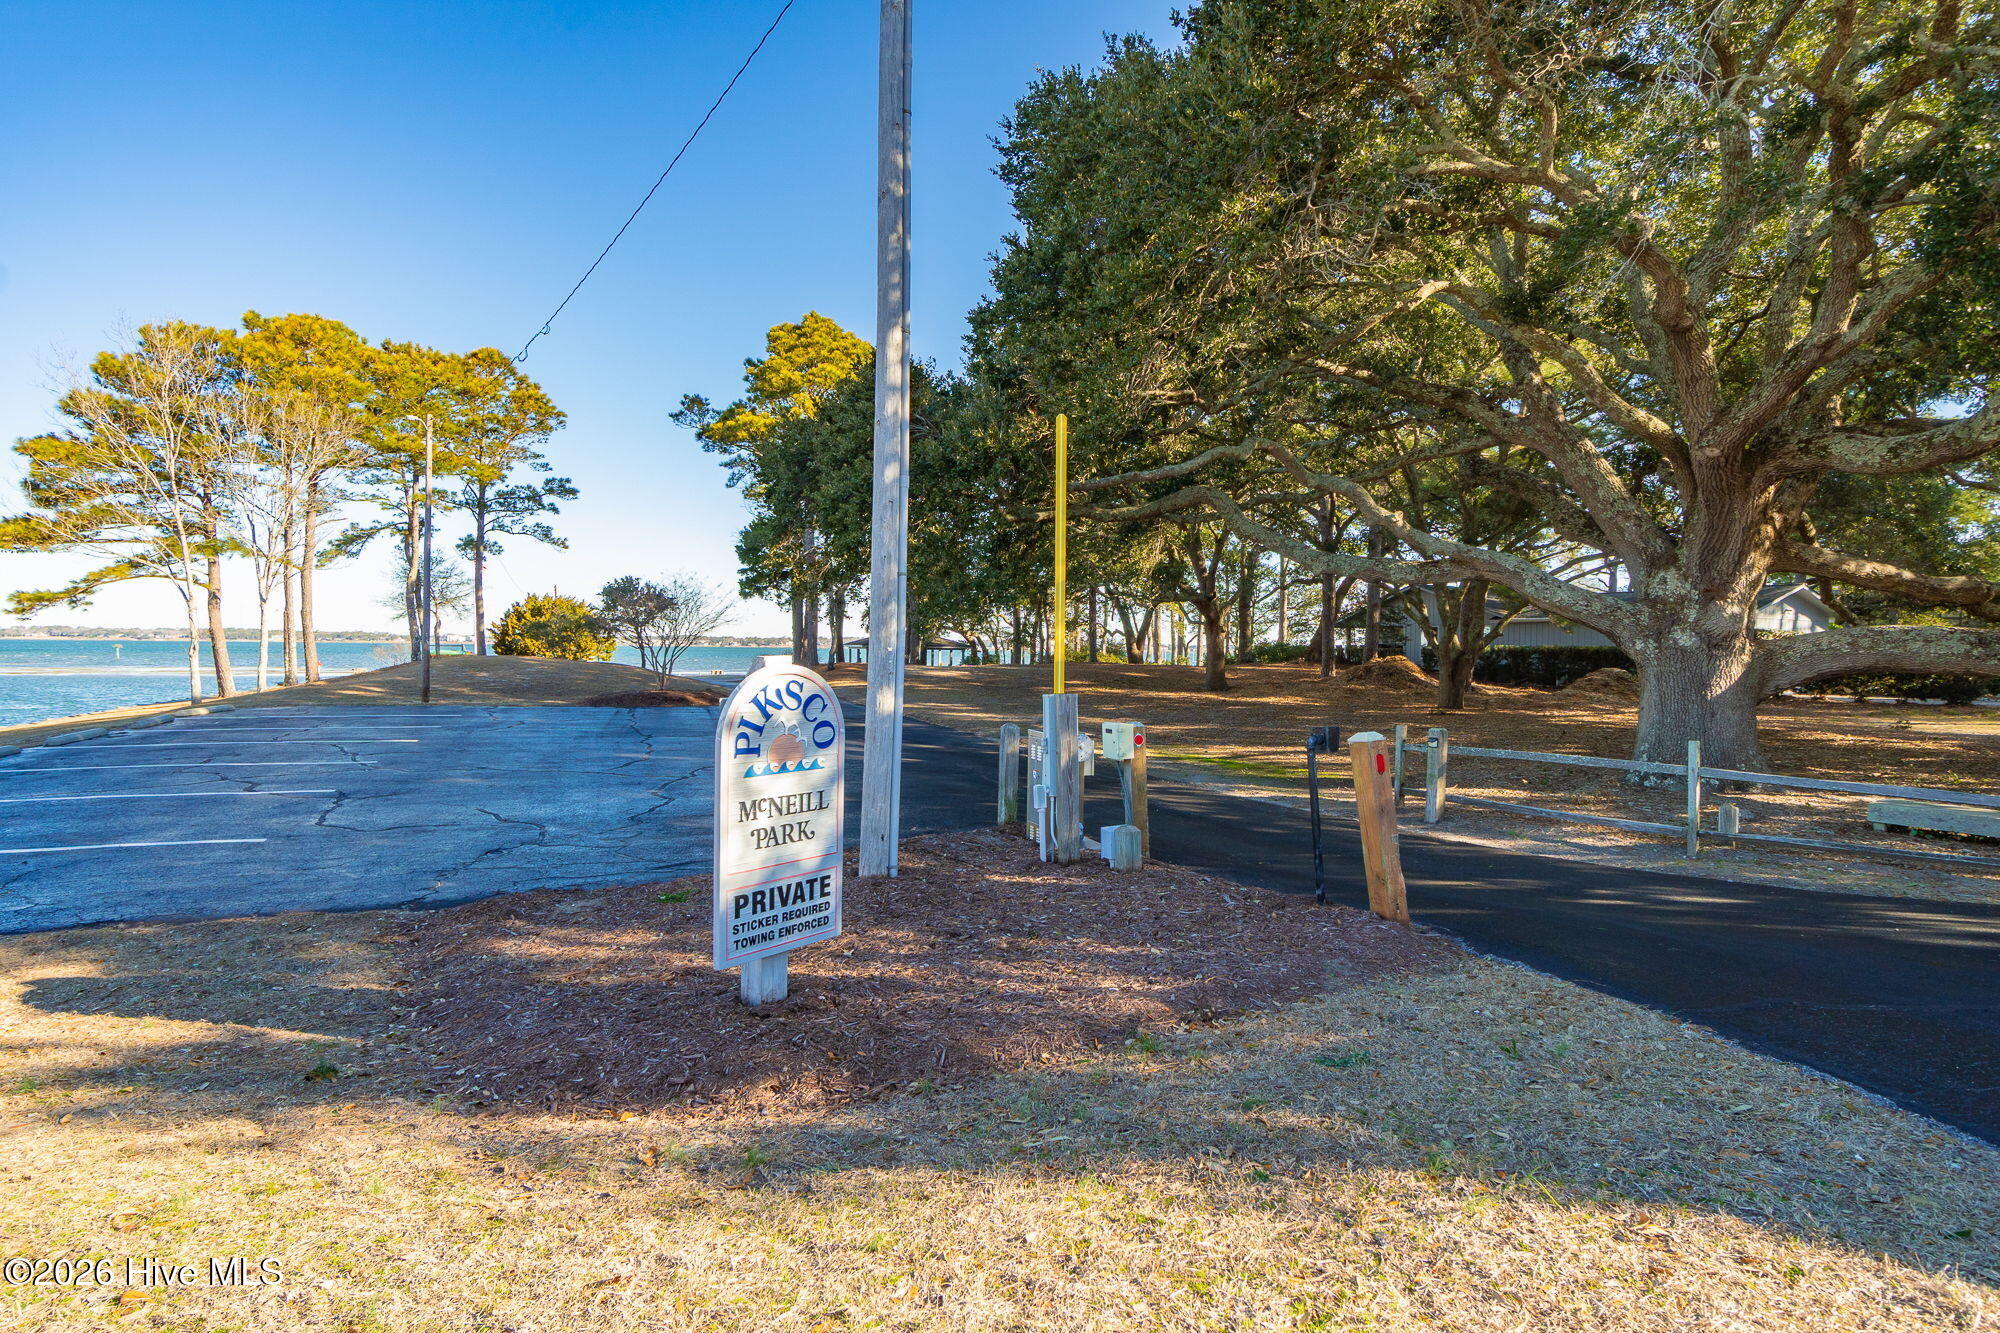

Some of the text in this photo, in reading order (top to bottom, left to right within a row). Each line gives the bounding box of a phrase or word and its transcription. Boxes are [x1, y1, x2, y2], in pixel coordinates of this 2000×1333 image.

[734, 680, 836, 759] PIKSCO
[750, 820, 816, 850] PARK
[734, 875, 831, 920] PRIVATE
[732, 901, 831, 936] STICKER REQUIRED
[734, 915, 830, 951] TOWING ENFORCED
